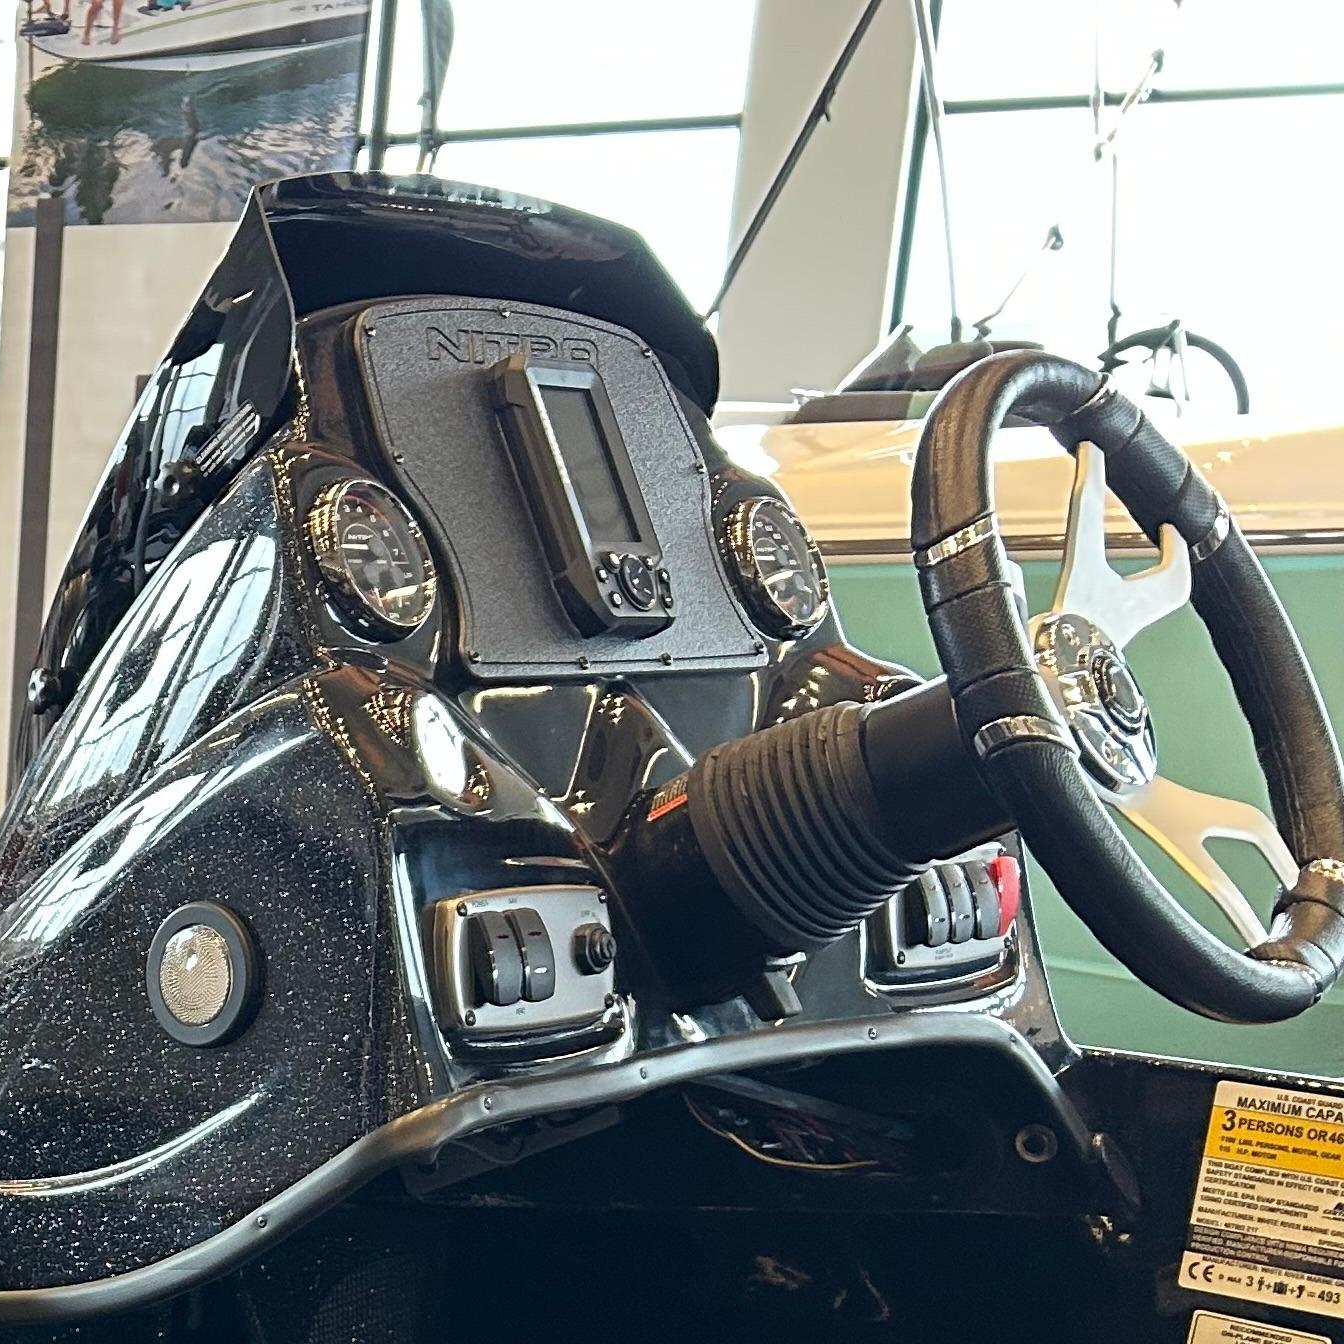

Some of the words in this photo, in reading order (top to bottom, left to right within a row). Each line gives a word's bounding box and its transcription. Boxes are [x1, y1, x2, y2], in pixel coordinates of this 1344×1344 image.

[1237, 1096, 1303, 1116] MAXIMUM
[1221, 1109, 1237, 1131] 3
[1238, 1117, 1304, 1138] PERSONS
[1307, 1128, 1328, 1143] OR
[1245, 1275, 1254, 1287] 3
[1317, 1290, 1341, 1305] 493
